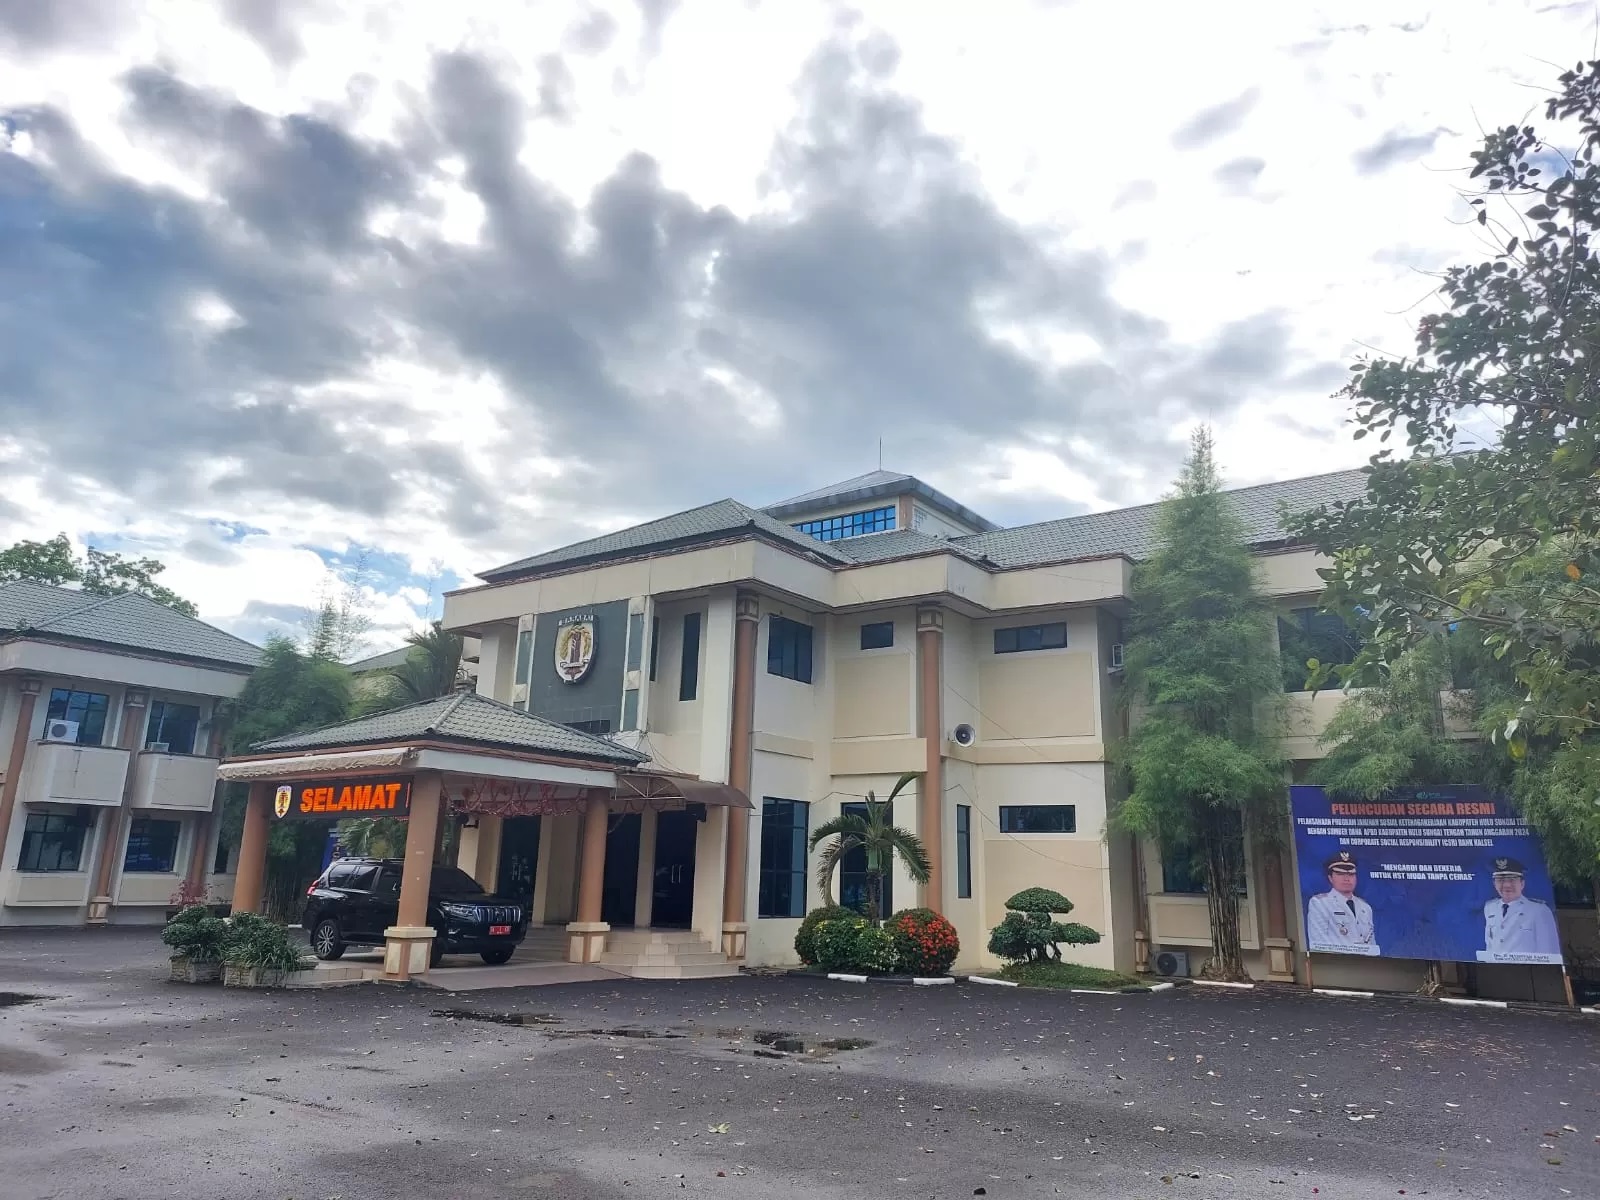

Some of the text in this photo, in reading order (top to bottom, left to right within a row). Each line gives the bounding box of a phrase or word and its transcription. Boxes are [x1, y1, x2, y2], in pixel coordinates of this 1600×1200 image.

[301, 784, 401, 812] SELAMAT
[1331, 803, 1495, 815] PELUNCURAN SECARA RESMI
[1297, 817, 1331, 825] PELAKSANAAN
[1379, 818, 1398, 826] SOSIAL
[1447, 818, 1478, 826] KABUPATEN
[1479, 818, 1494, 826] HULU
[1494, 818, 1516, 826] SUNGAI
[1307, 827, 1530, 837] DENGAN SUMBER DANA APBD KABUPATEN HULU SUNGAI TENGAH TAHUN ANGGARAN 2024
[1339, 837, 1494, 847] DAN CORPORATE SOCIAL RESPONSIBILITY (CSR) BANK KALSEL
[1418, 864, 1433, 872] DAN
[1433, 864, 1463, 872] BEKERJA
[1369, 871, 1392, 879] UNTUK
[1406, 872, 1427, 880] MUDA
[1426, 872, 1448, 880] TANPA
